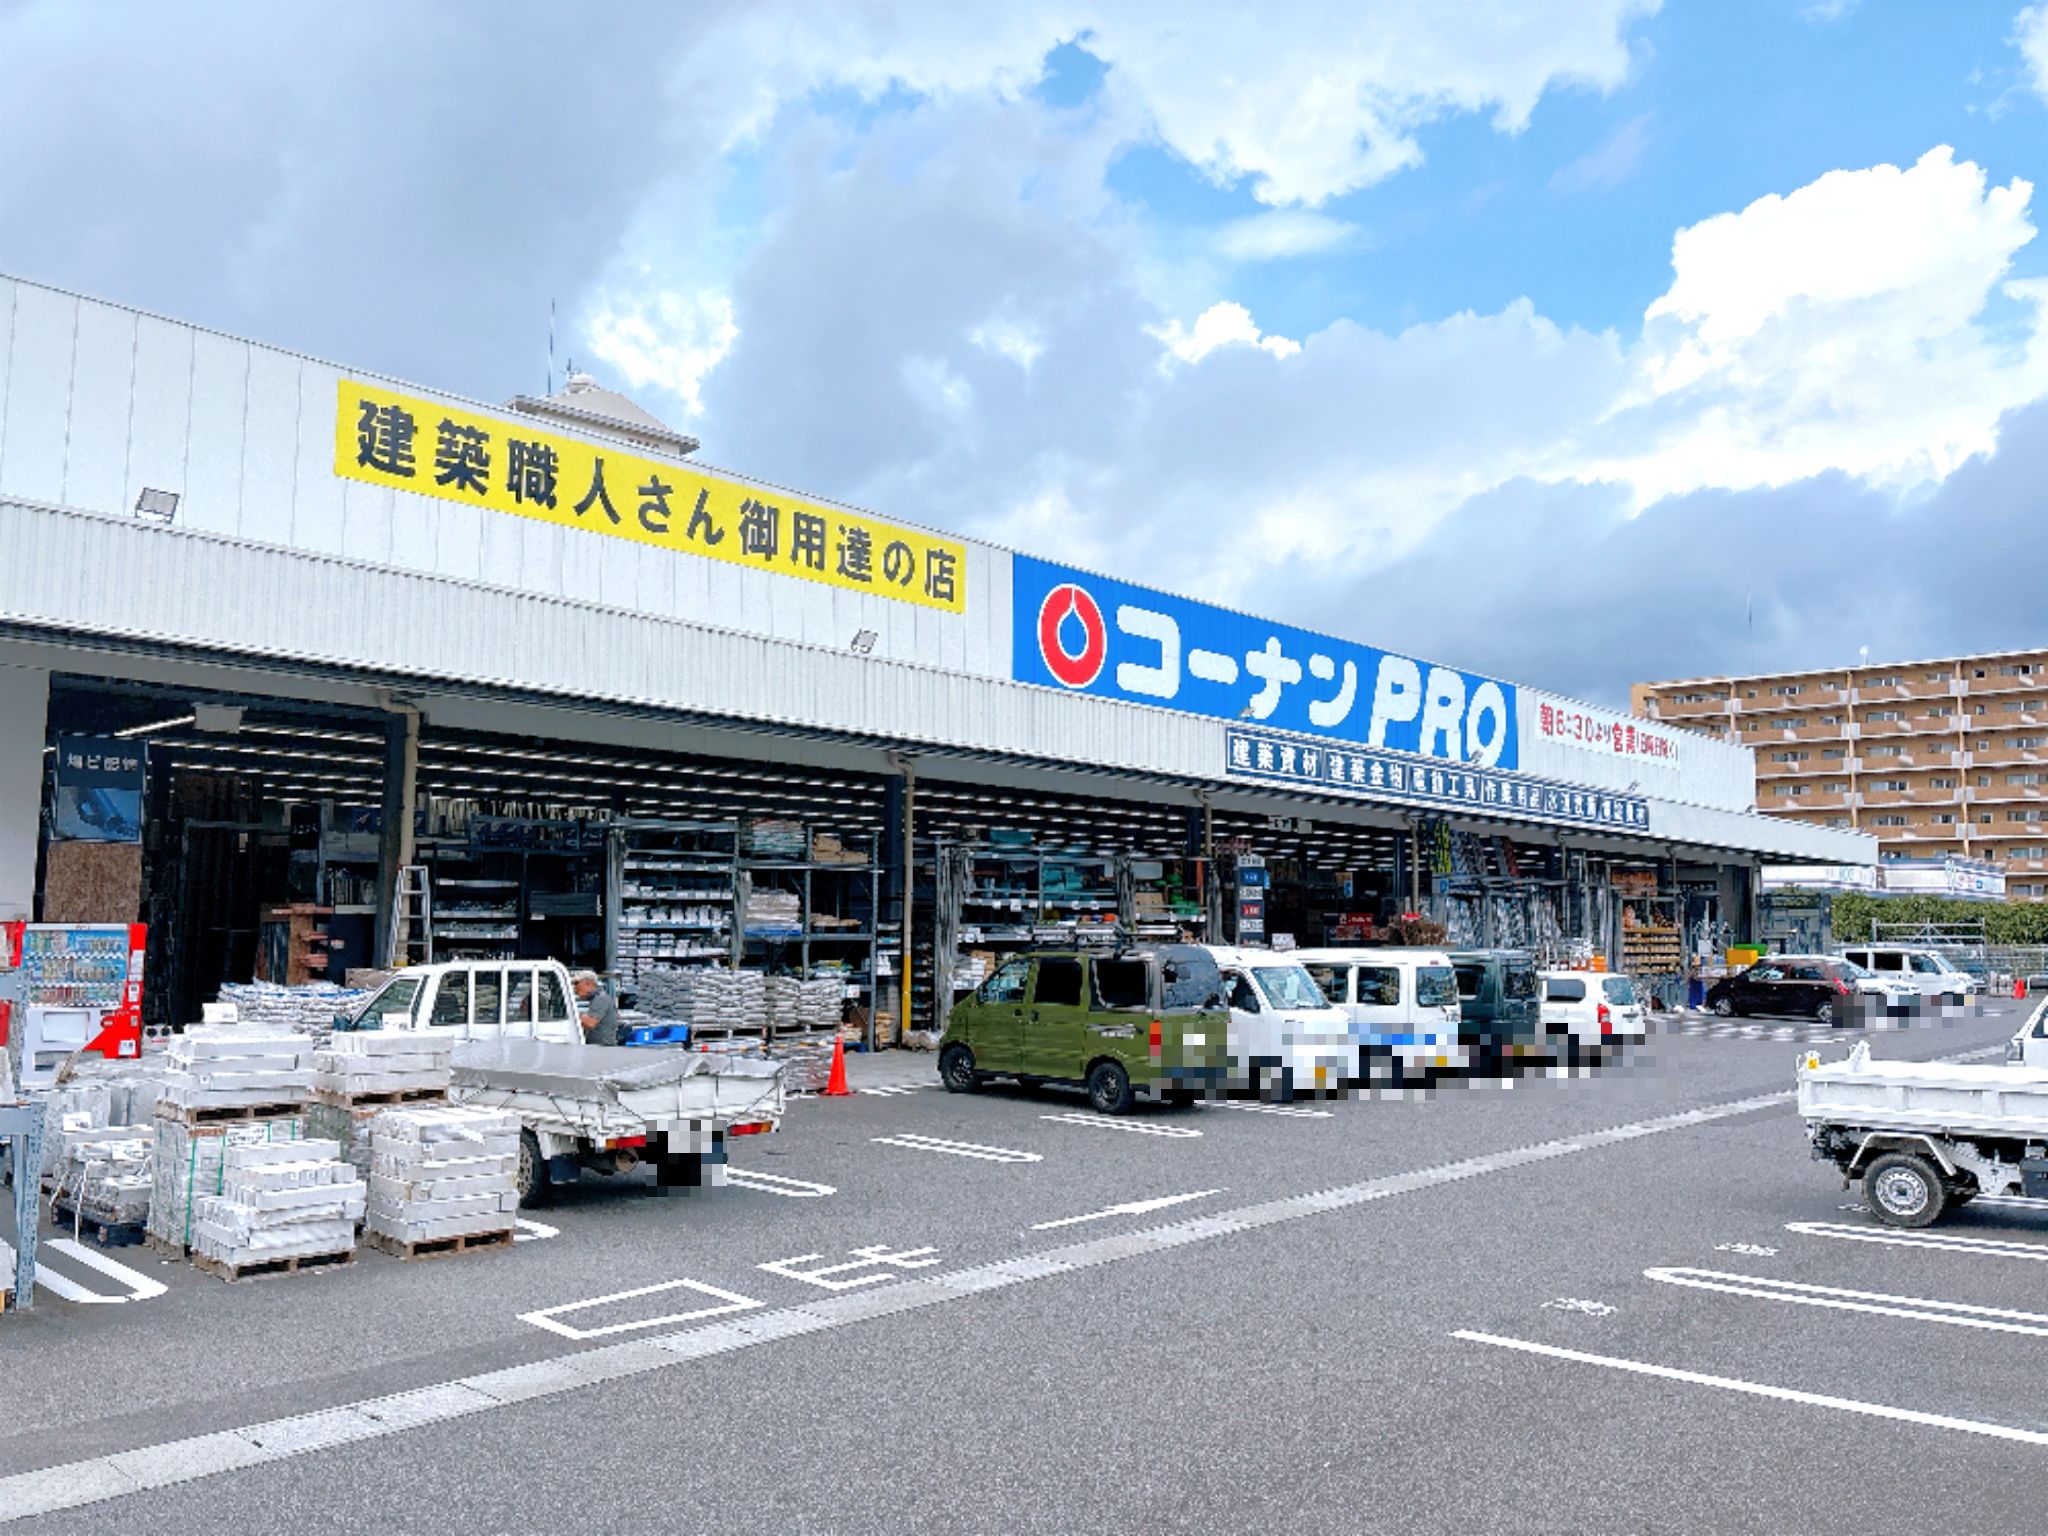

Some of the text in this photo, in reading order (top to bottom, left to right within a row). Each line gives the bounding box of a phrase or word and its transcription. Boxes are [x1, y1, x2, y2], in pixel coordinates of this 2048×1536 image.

[357, 399, 956, 603] 建築職人さん御用達の店
[1116, 603, 1507, 767] コーナンPRO
